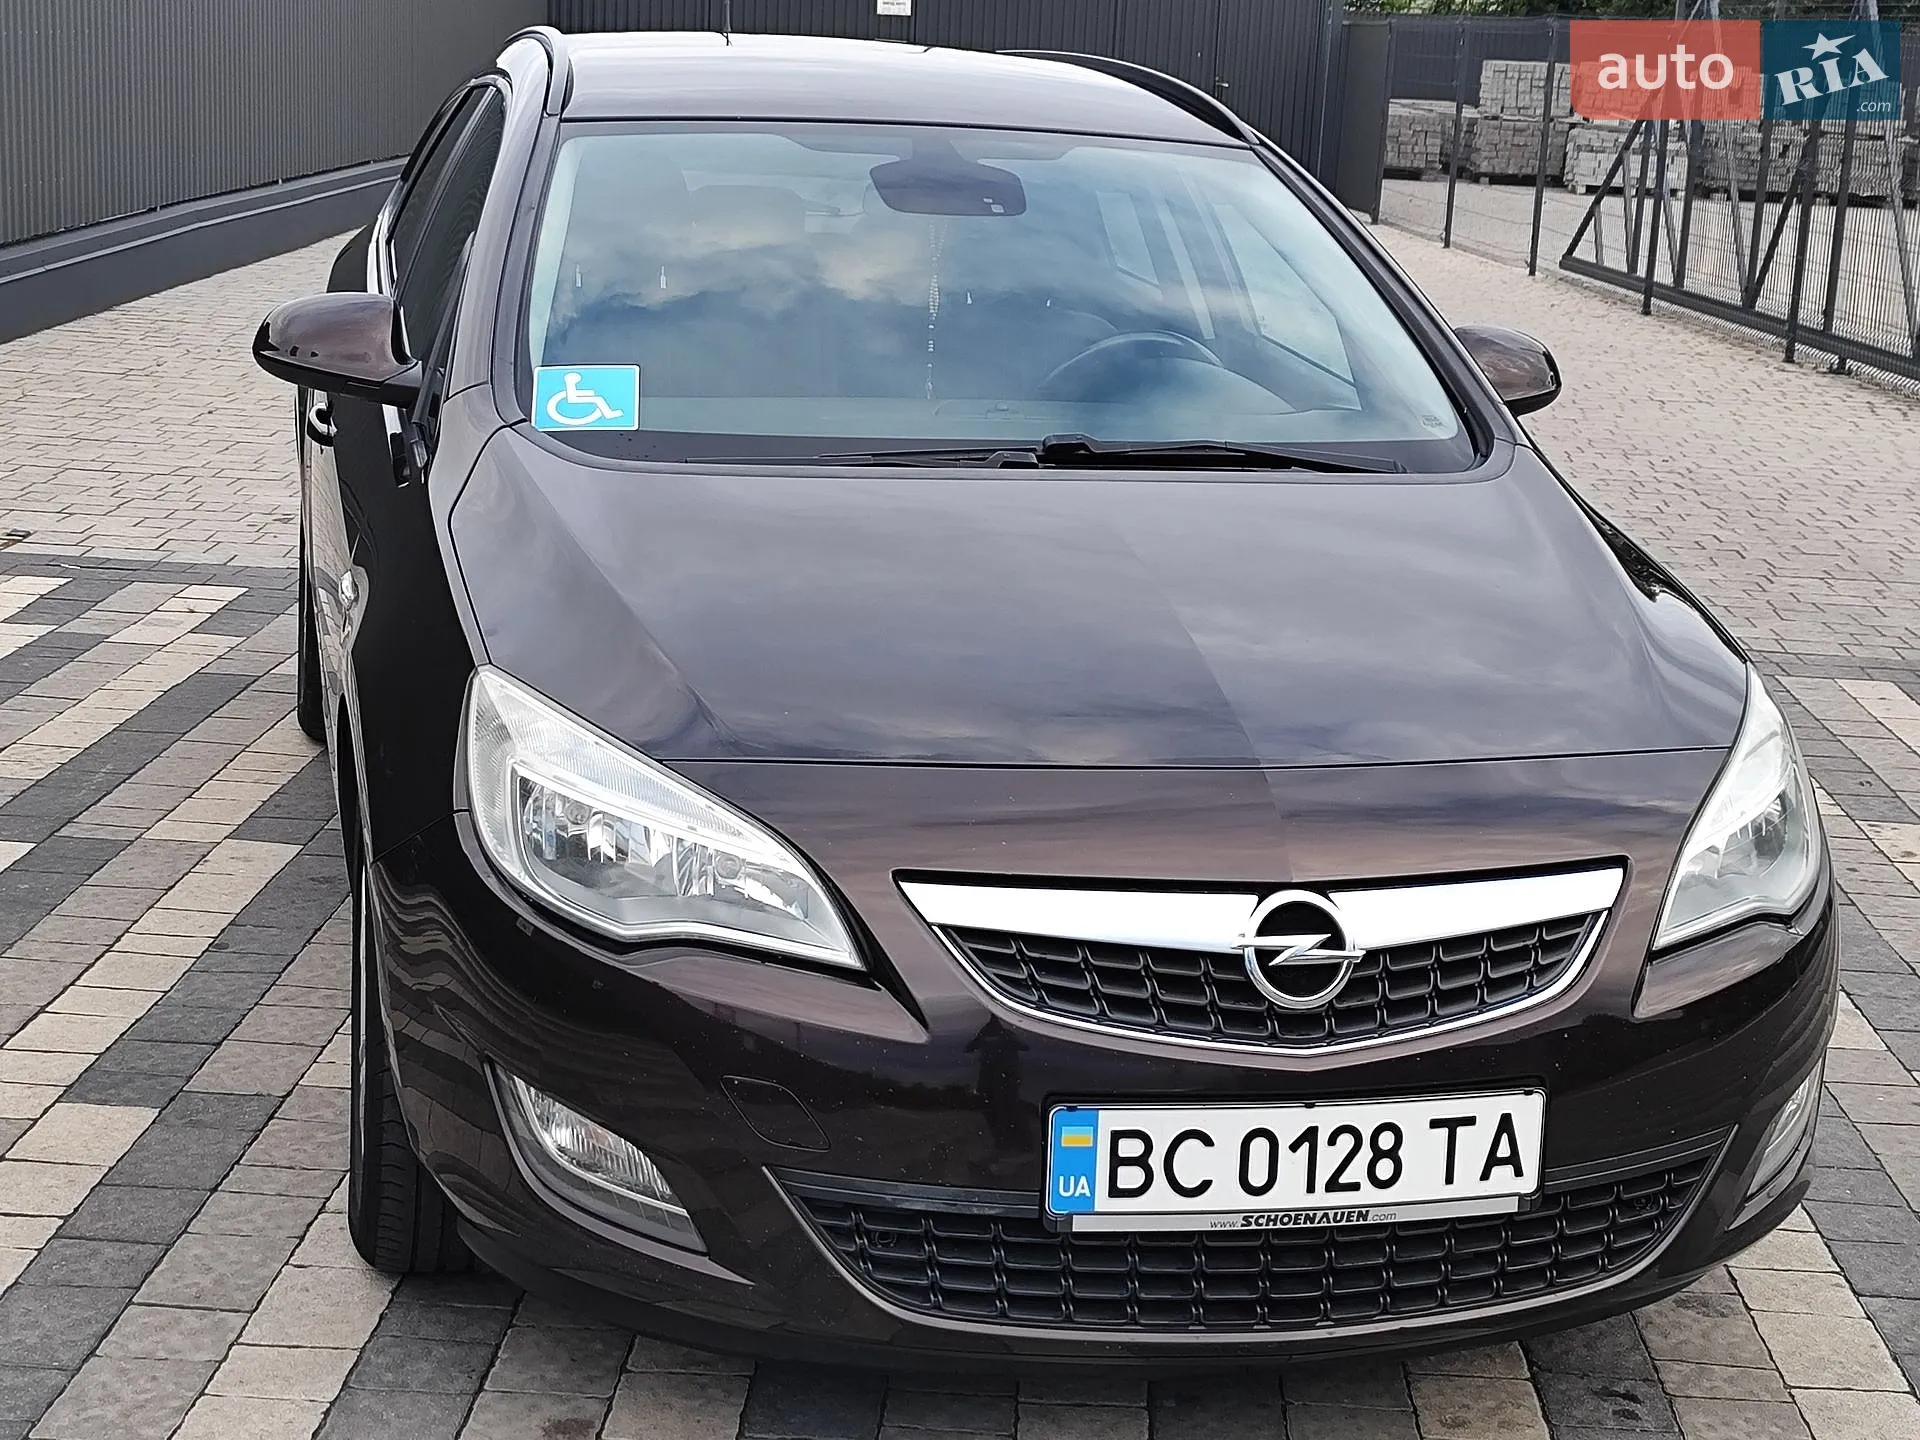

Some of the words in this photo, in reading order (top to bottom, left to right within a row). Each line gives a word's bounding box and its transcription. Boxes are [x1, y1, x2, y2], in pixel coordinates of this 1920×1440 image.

[1107, 1128, 1215, 1199] BC
[1238, 1121, 1404, 1198] 0128
[1429, 1112, 1524, 1186] TA
[1058, 1175, 1092, 1198] UA
